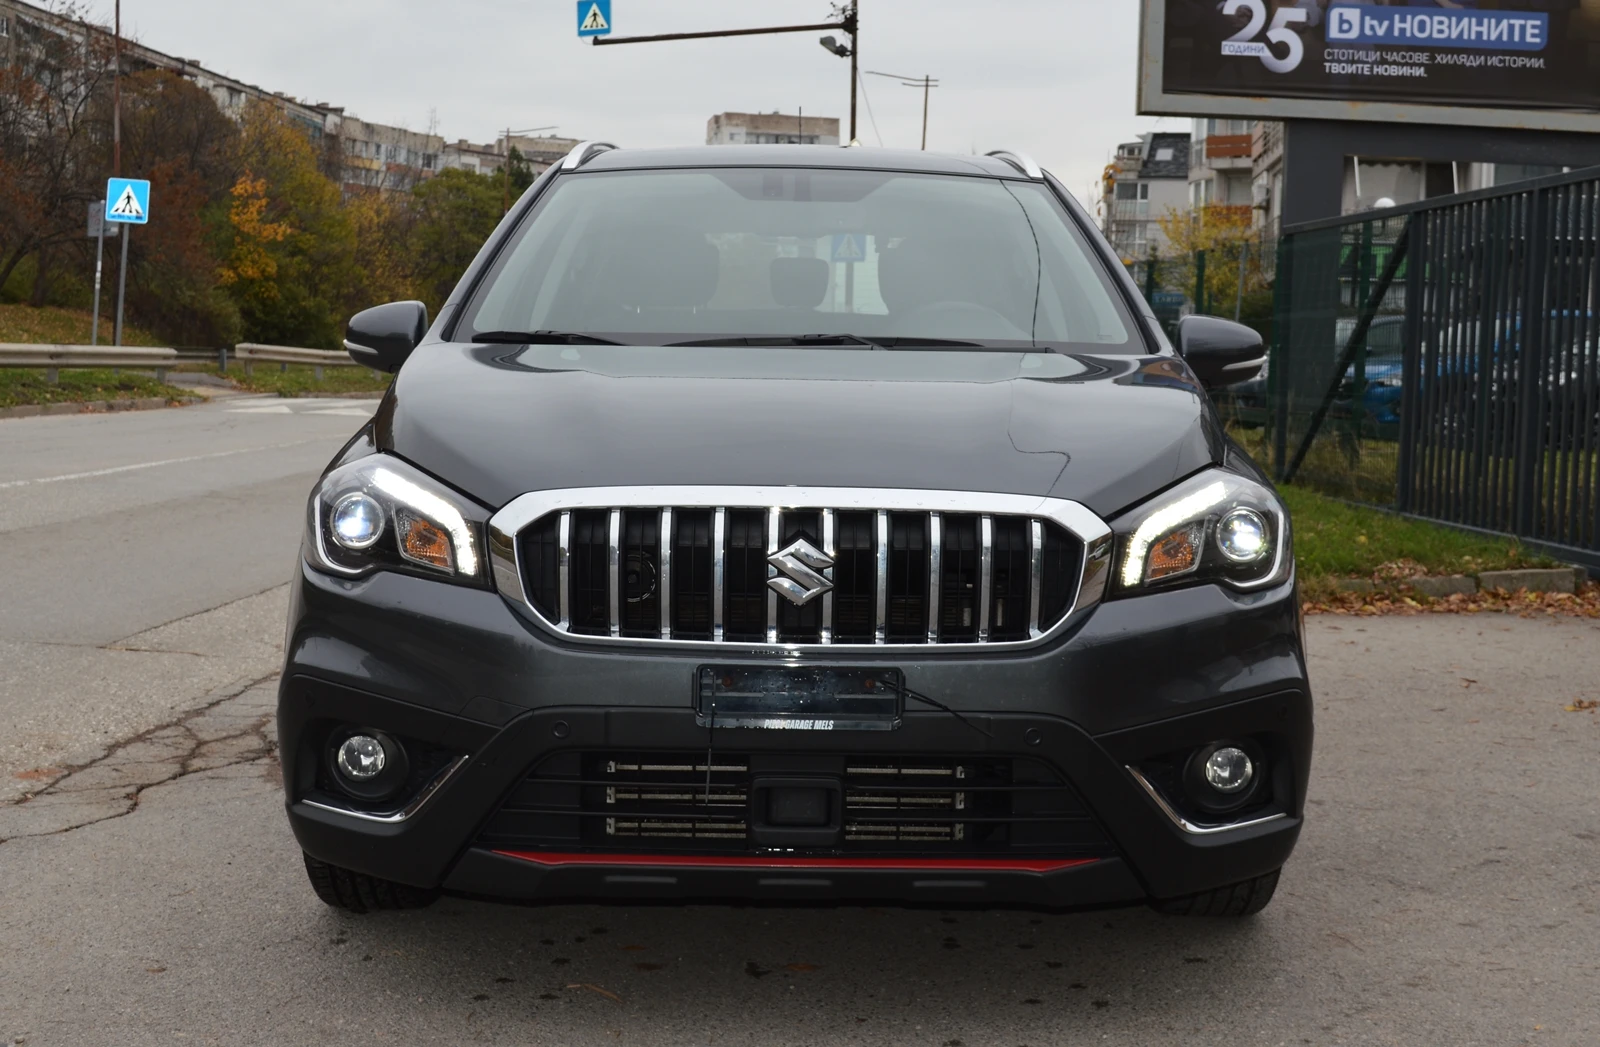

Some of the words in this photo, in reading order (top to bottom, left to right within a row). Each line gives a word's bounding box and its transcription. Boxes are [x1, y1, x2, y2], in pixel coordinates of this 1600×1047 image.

[1222, 0, 1307, 74] 25
[1393, 14, 1542, 43] НОВИНИТЕ
[1222, 44, 1265, 54] ГОДИНИ
[1324, 48, 1380, 62] СТОТИЦИ
[1382, 51, 1432, 64] ЧАСОВЕ.
[1435, 53, 1485, 67] ХИЛЯДИ
[1487, 56, 1546, 69] ИСТОРИИ.
[1323, 62, 1371, 75] ТВОИТЕ
[1373, 65, 1428, 77] НОВИНИ.
[785, 719, 813, 730] GARAGE
[813, 720, 834, 730] MELS
